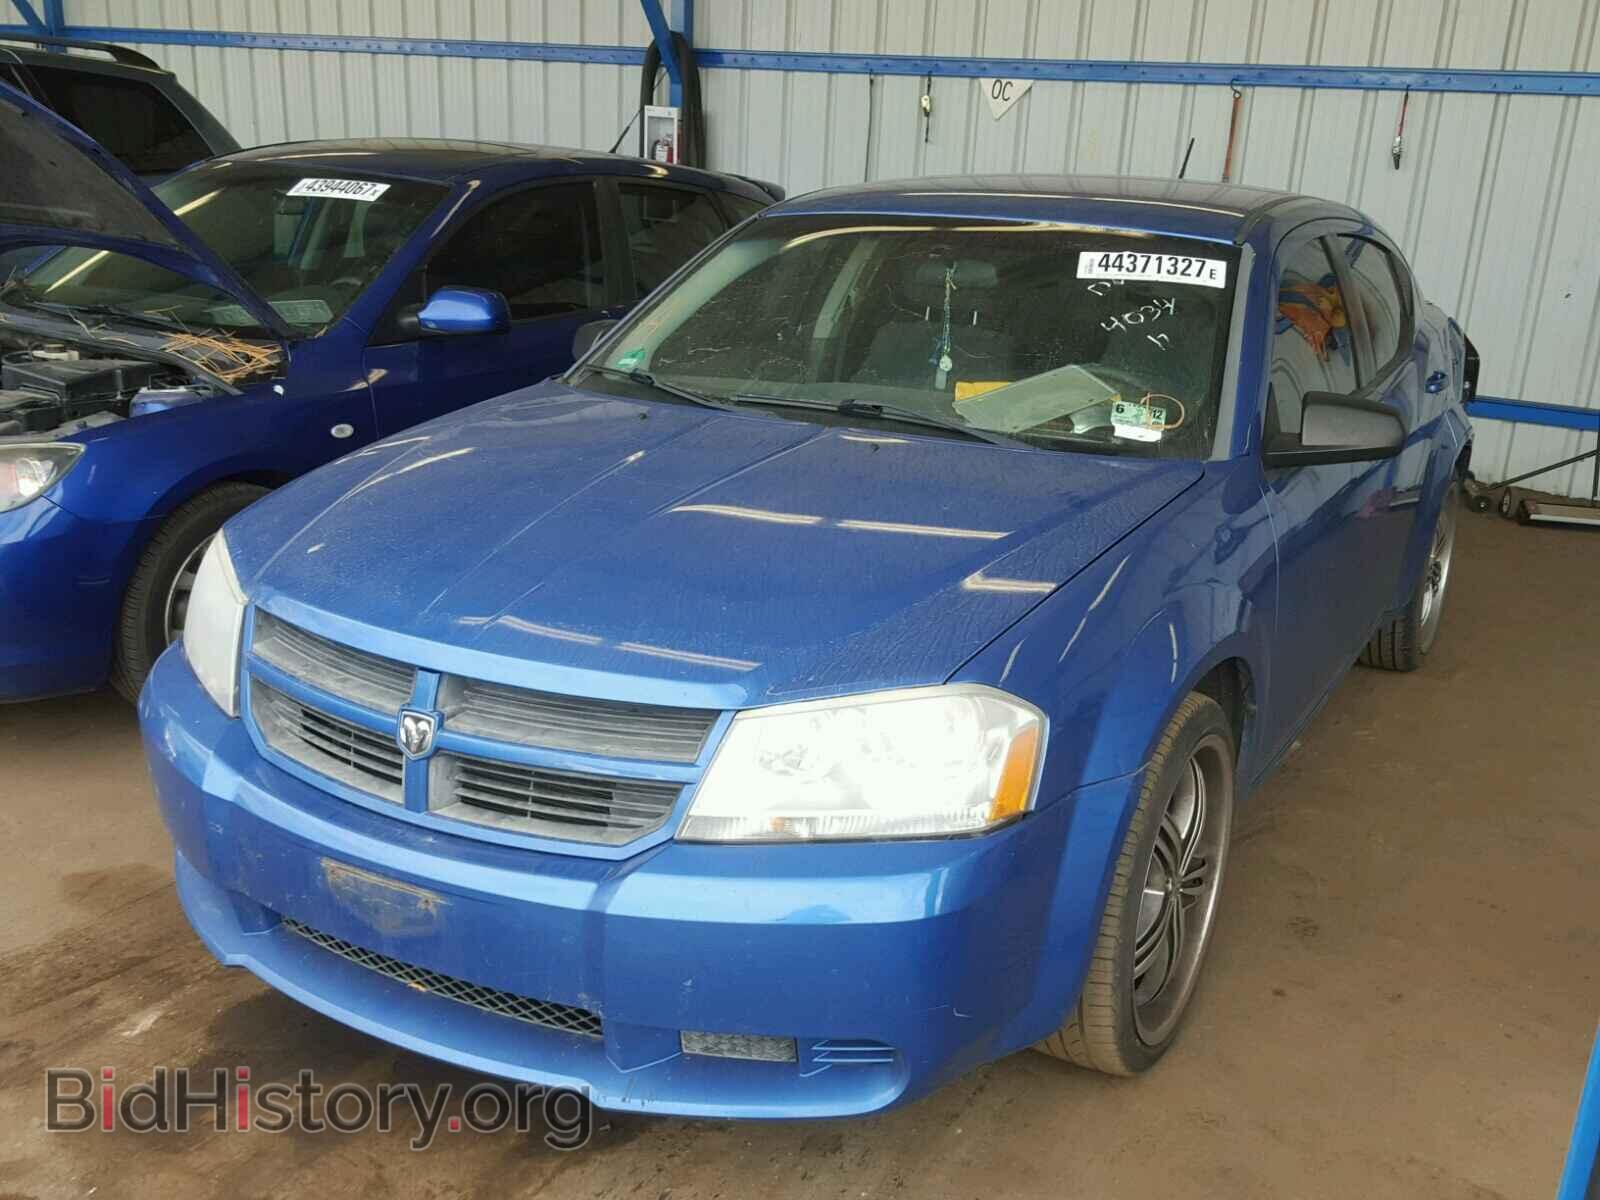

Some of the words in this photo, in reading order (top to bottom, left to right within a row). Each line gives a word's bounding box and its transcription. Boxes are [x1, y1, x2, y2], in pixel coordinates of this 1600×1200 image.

[991, 79, 1014, 102] OC
[305, 179, 377, 196] 43944067
[1098, 253, 1206, 278] 44371327
[1210, 268, 1217, 280] E
[1115, 403, 1125, 415] 6
[1152, 408, 1164, 420] 12
